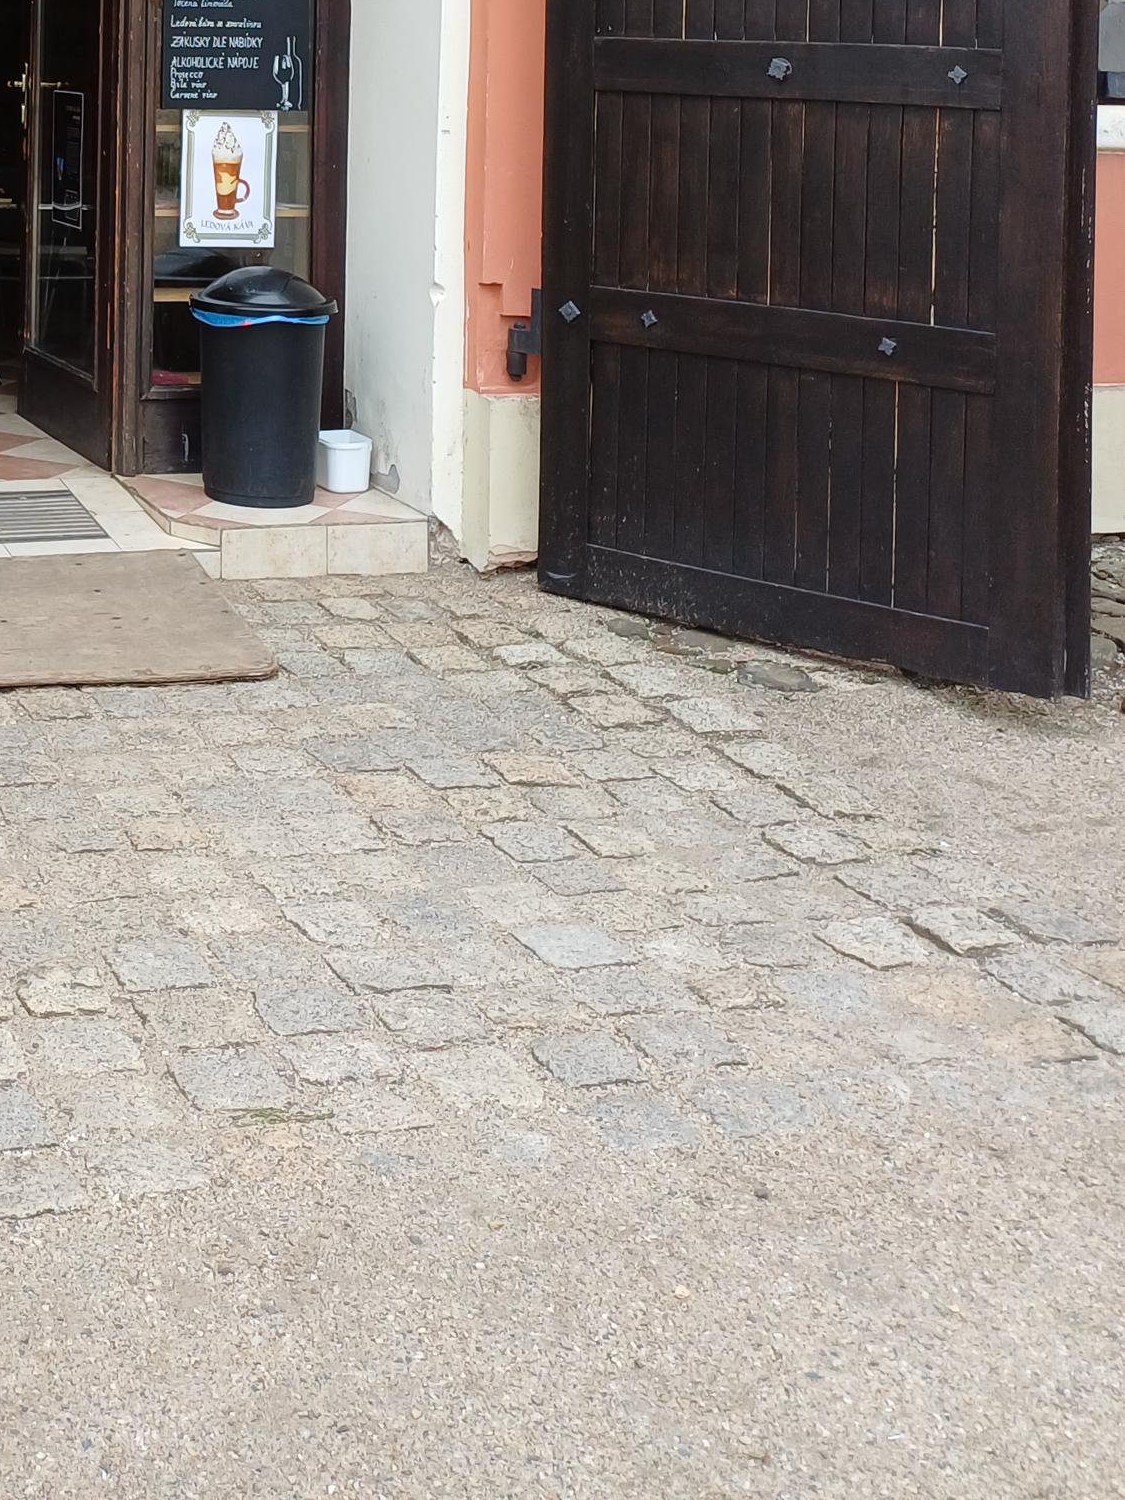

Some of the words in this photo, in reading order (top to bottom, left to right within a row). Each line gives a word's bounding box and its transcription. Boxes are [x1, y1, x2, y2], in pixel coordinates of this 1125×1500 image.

[170, 31, 211, 48] ZÁKUSKY
[212, 36, 228, 48] DLE
[229, 32, 263, 48] NABÍDKY
[170, 52, 225, 69] ALKOHOLICKÉ
[227, 52, 260, 69] NÁPOJE
